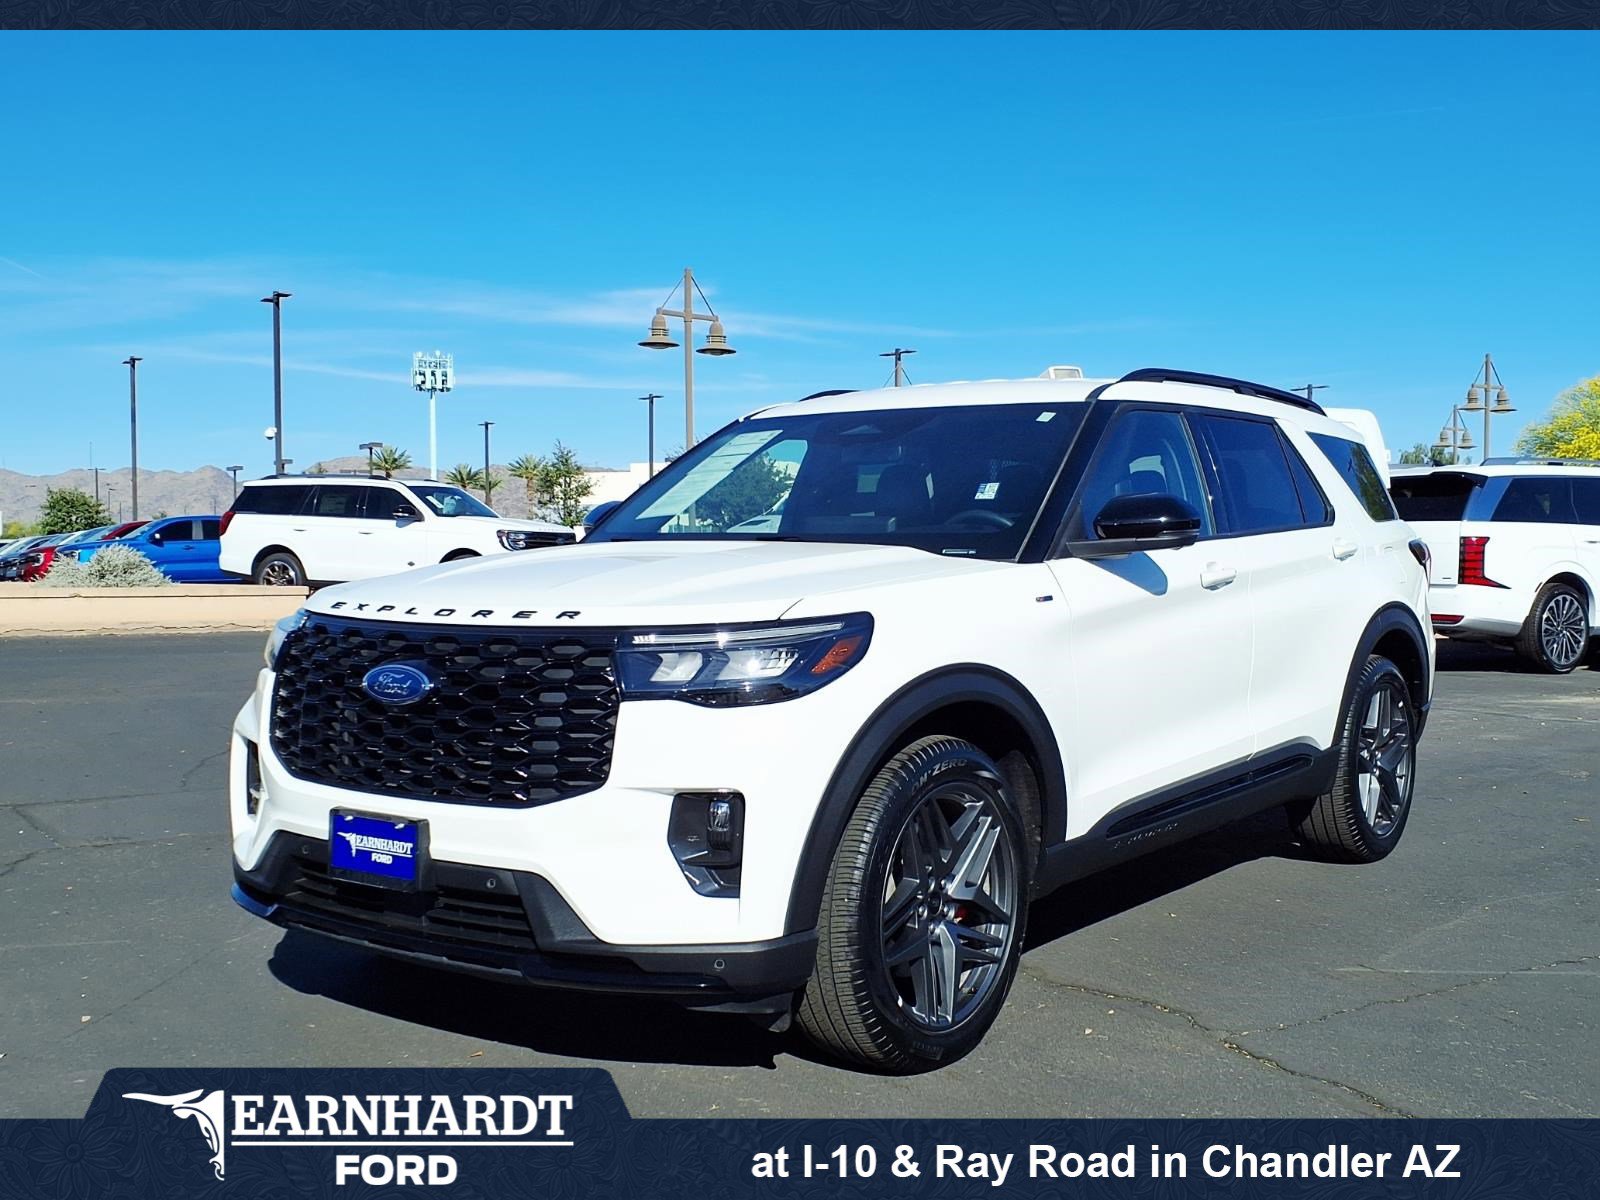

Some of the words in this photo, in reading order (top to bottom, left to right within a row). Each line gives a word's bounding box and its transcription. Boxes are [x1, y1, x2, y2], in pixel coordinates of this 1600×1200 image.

[330, 601, 581, 620] EXPLORER
[355, 834, 414, 855] EARNHARDT
[371, 852, 393, 865] FORD
